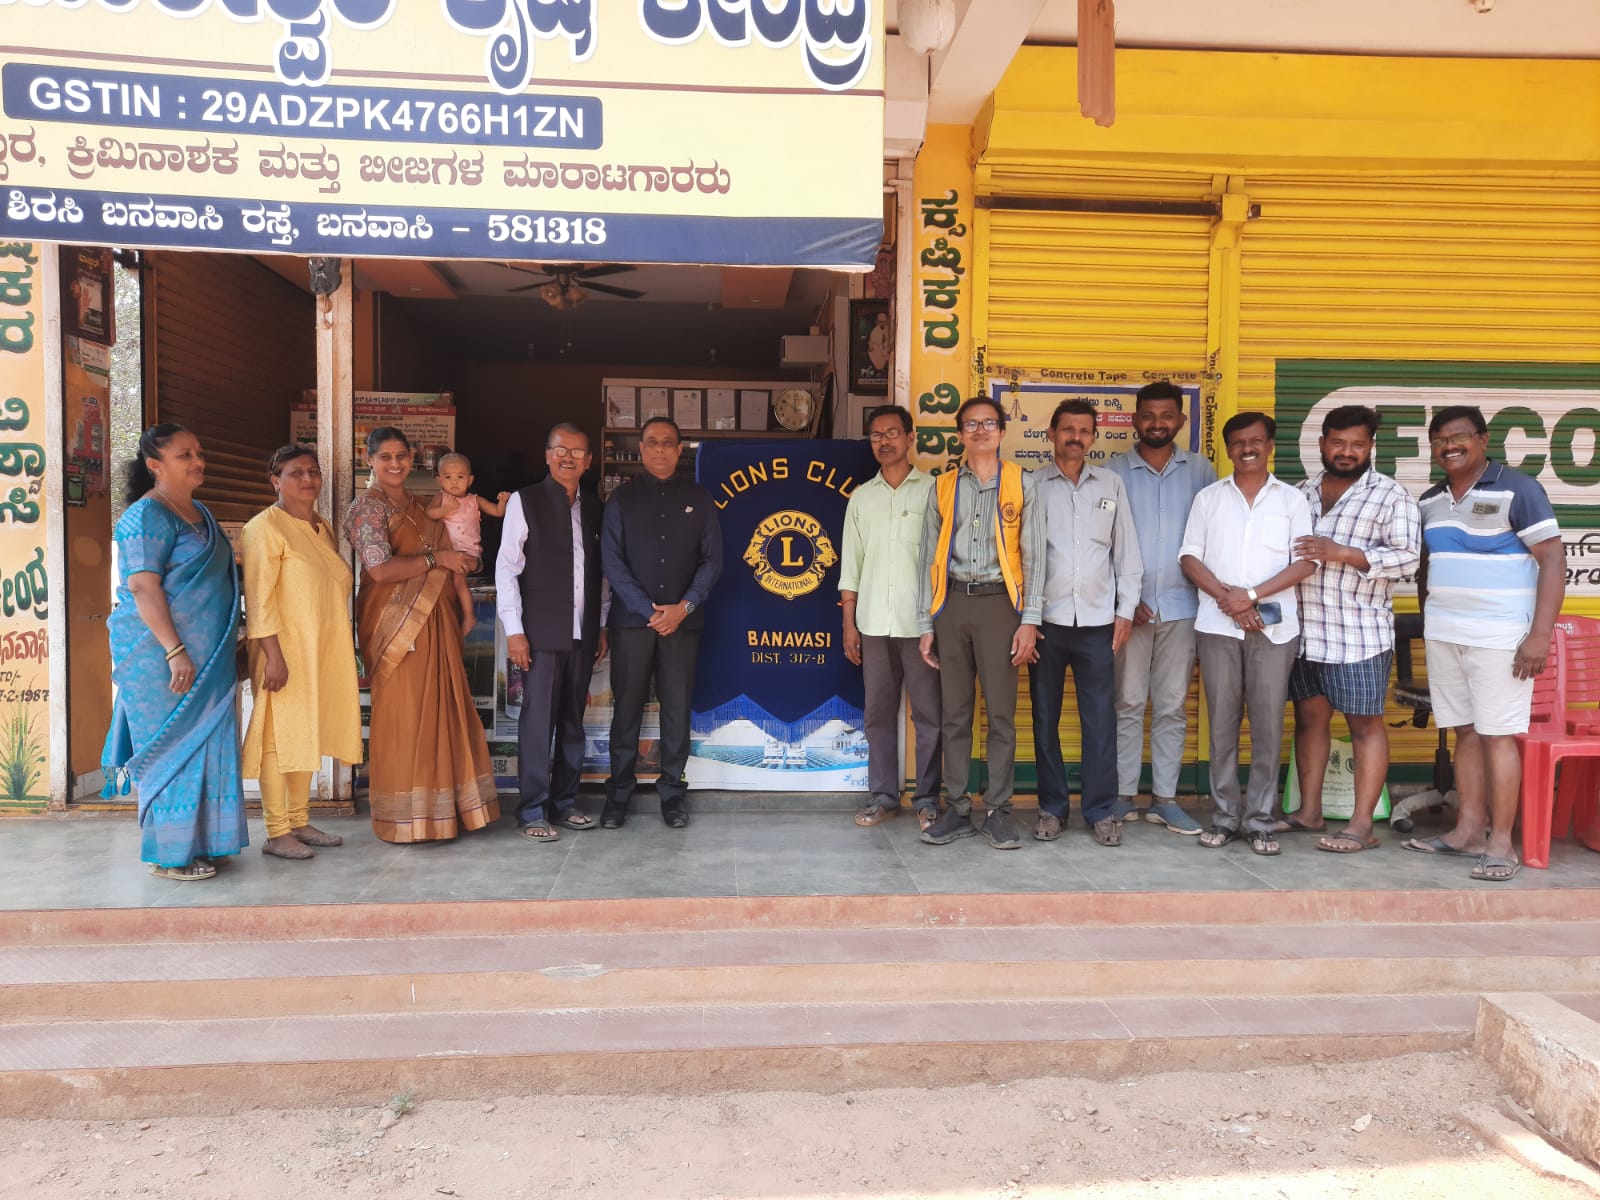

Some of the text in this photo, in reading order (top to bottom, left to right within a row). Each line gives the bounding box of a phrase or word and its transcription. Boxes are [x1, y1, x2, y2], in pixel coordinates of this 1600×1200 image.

[28, 77, 162, 118] GSTIN
[202, 89, 585, 139] 29ADZPK4766H1ZN
[66, 134, 239, 180] ಕ್ರಿಮಿನಾಶಕ
[258, 141, 342, 194] ಮತ್ತು
[359, 148, 484, 187] ಬೀಜಗಳ
[503, 152, 732, 195] ಮಾರಾಟಗಾರರು
[6, 190, 85, 225] ಶಿರಸಿ
[101, 196, 224, 231] ಬನವಾಸಿ
[241, 203, 300, 246] ರಸ್ತೆ,
[316, 207, 434, 241] ಬನವಾಸಿ
[487, 214, 608, 245] 581318
[1040, 367, 1095, 381] Concrete
[1098, 371, 1128, 382] Tape
[714, 457, 861, 510] LIONS CLU
[763, 514, 818, 535] LIONS
[779, 536, 805, 567] L
[763, 574, 815, 591] INTERNATIONAL
[747, 630, 832, 648] BANAVASI
